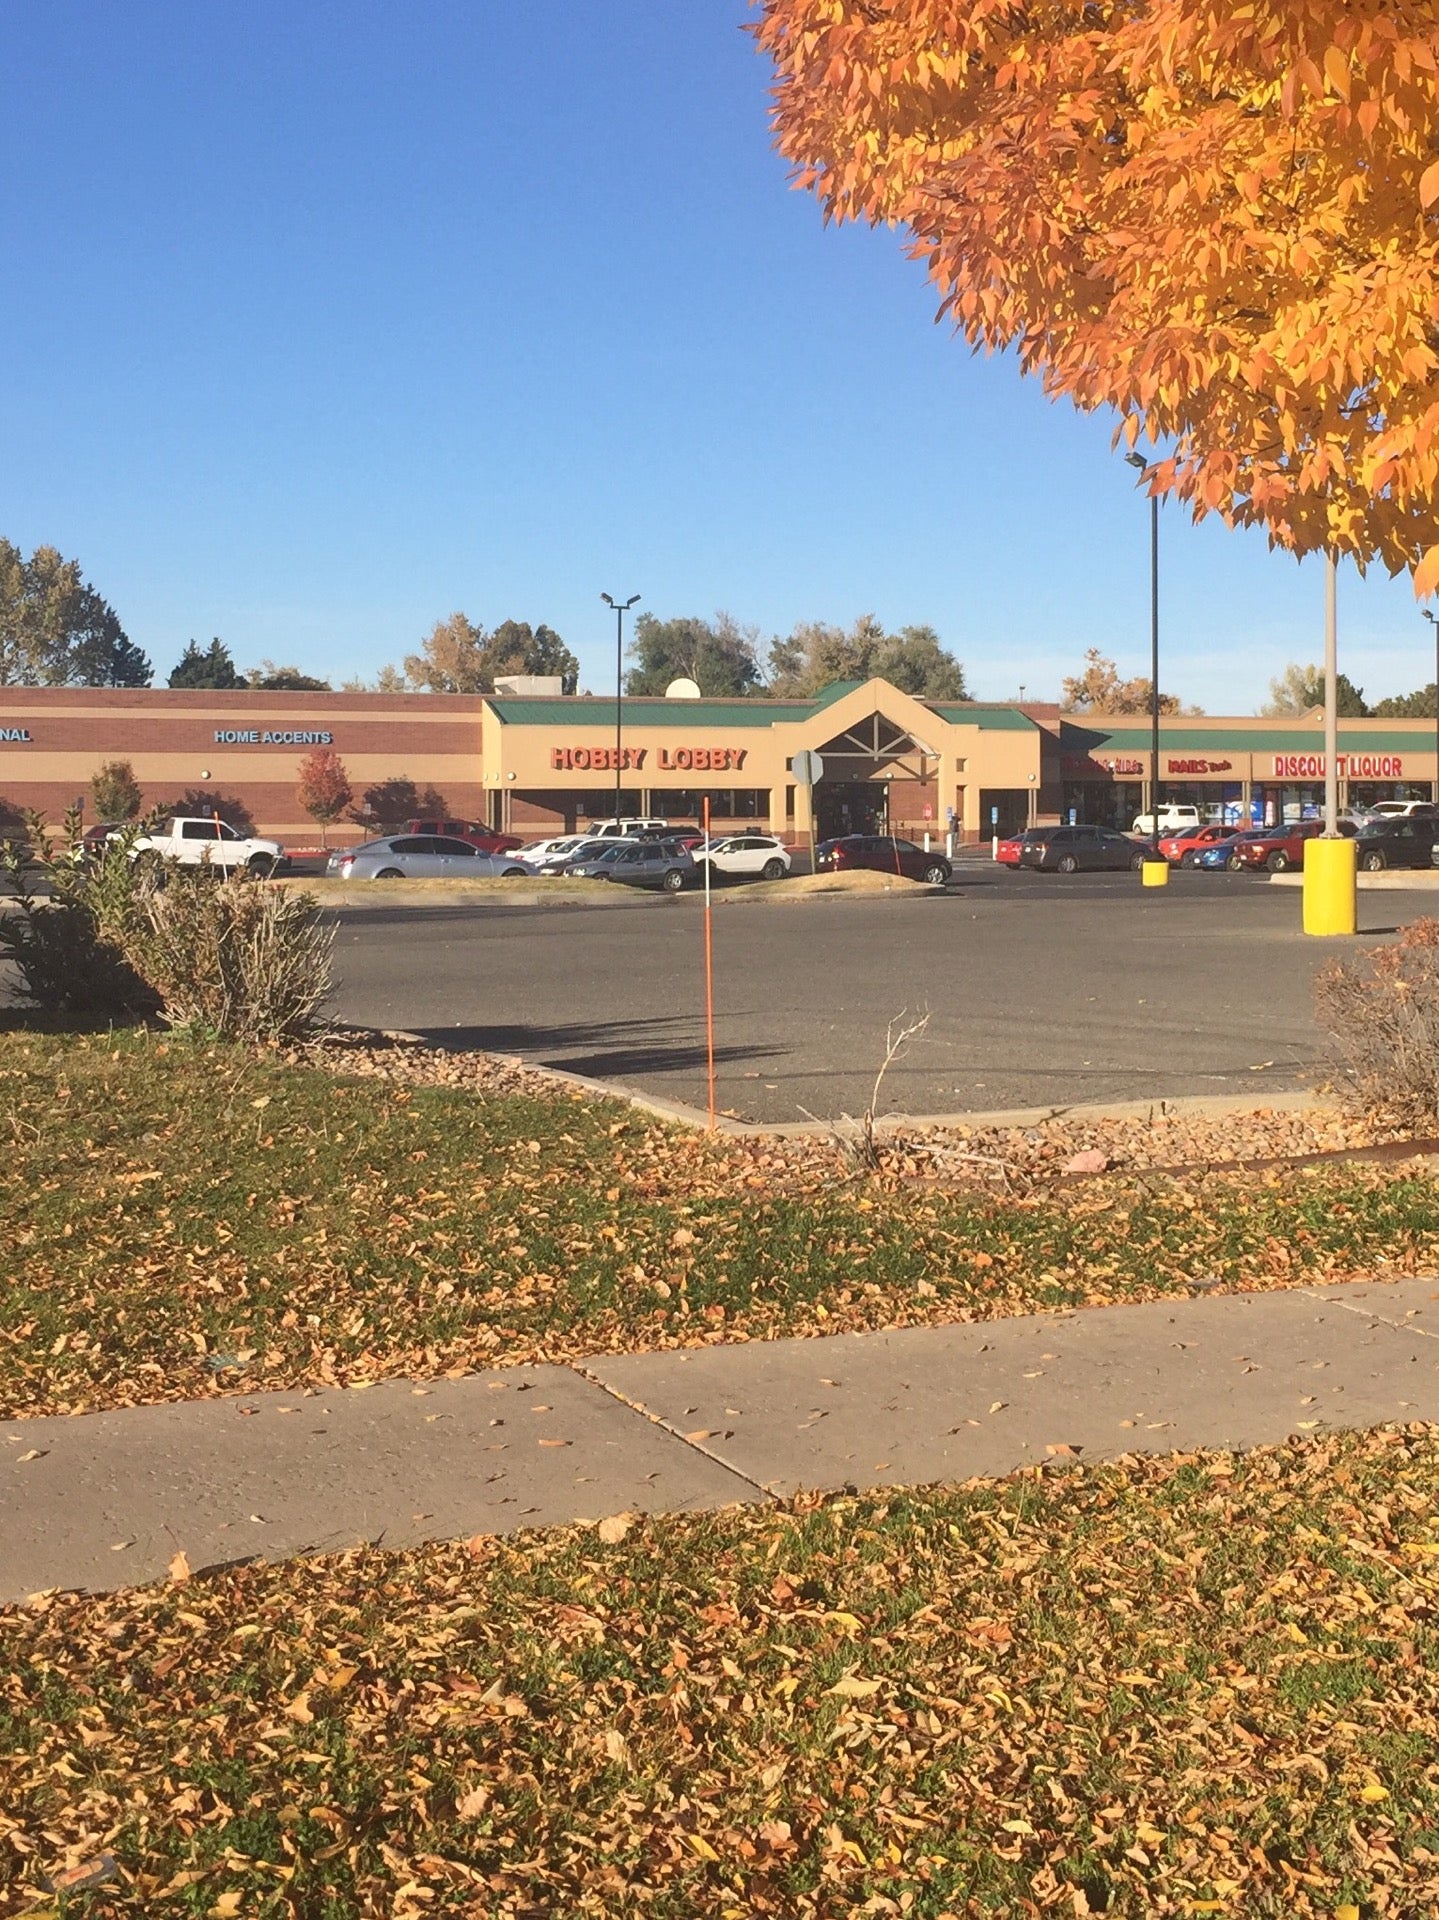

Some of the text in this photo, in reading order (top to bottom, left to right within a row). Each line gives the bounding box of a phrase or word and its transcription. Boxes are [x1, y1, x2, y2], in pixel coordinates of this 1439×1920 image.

[0, 728, 31, 741] NAL
[214, 731, 332, 744] HOME ACCENTS
[551, 747, 747, 770] HOBBY LOBBY
[1168, 760, 1208, 773] NAILS
[1273, 756, 1402, 778] DISCOUT LIQUOR
